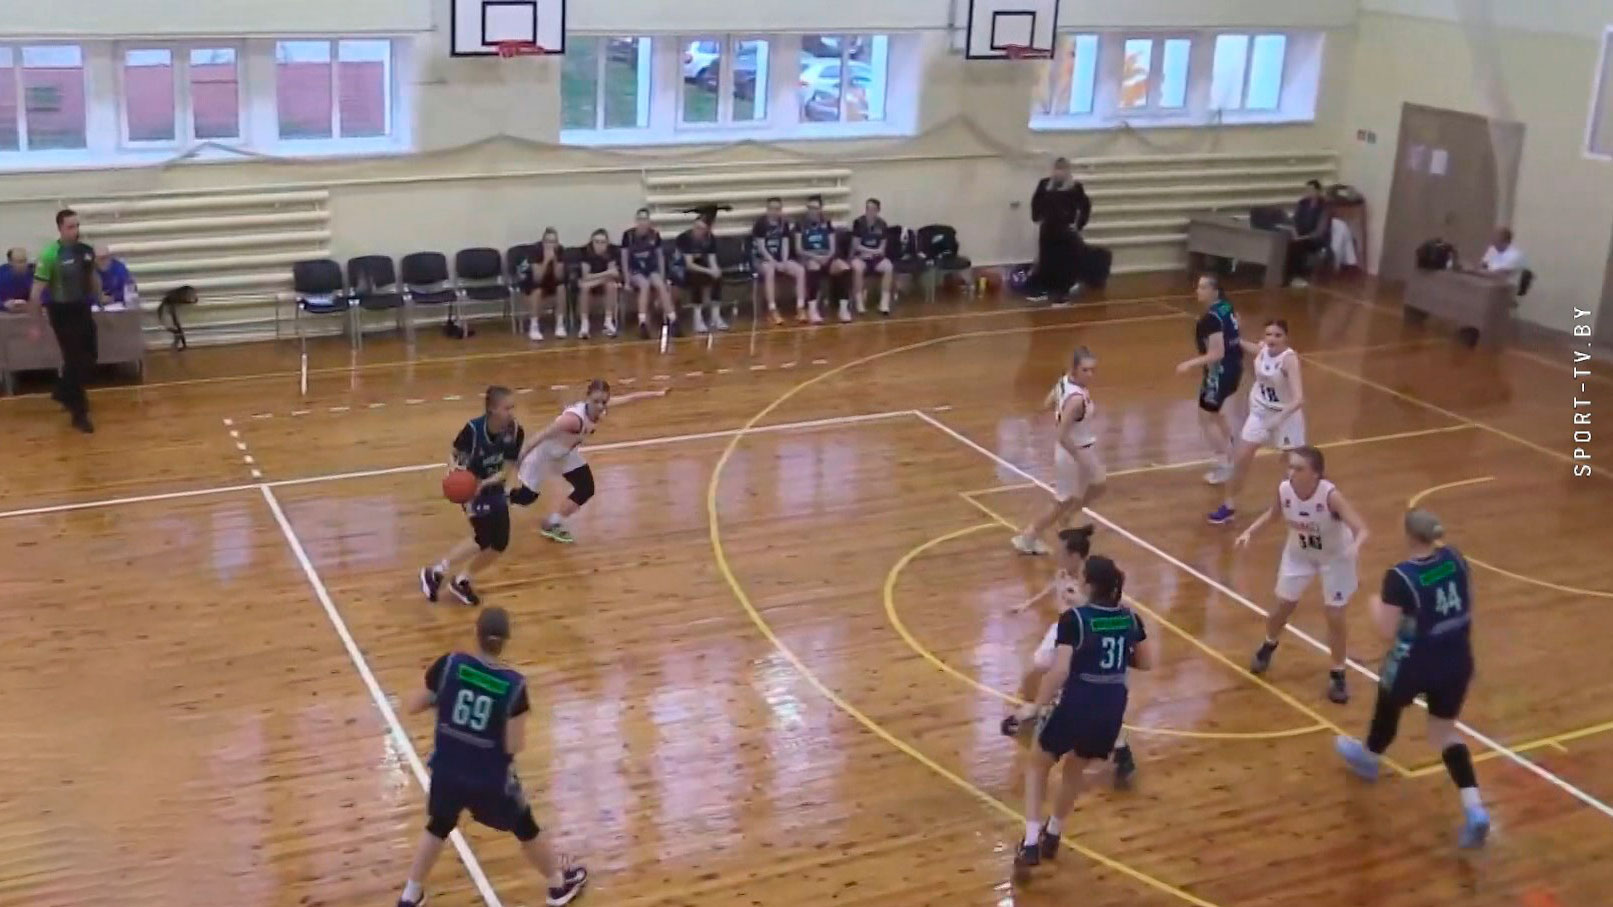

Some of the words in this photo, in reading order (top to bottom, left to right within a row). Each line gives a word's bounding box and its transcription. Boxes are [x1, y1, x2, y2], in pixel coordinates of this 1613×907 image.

[1435, 581, 1462, 616] 44
[1100, 636, 1125, 670] 31
[452, 689, 492, 731] 69
